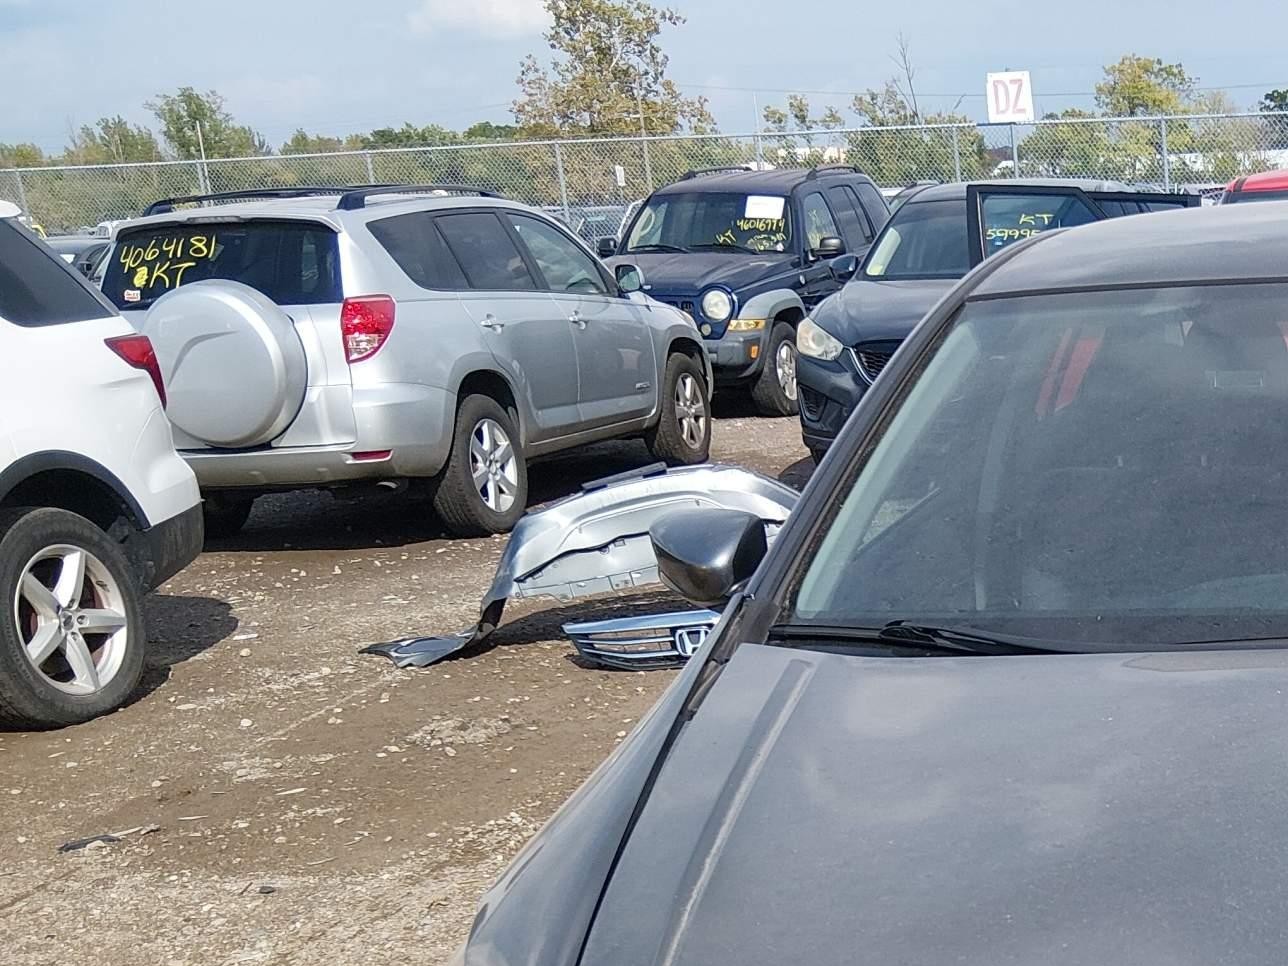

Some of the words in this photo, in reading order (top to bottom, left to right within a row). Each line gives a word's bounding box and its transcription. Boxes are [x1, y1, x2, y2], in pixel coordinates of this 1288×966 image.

[992, 79, 1027, 115] DZ
[1019, 213, 1055, 225] KT
[120, 234, 216, 274] 4064181
